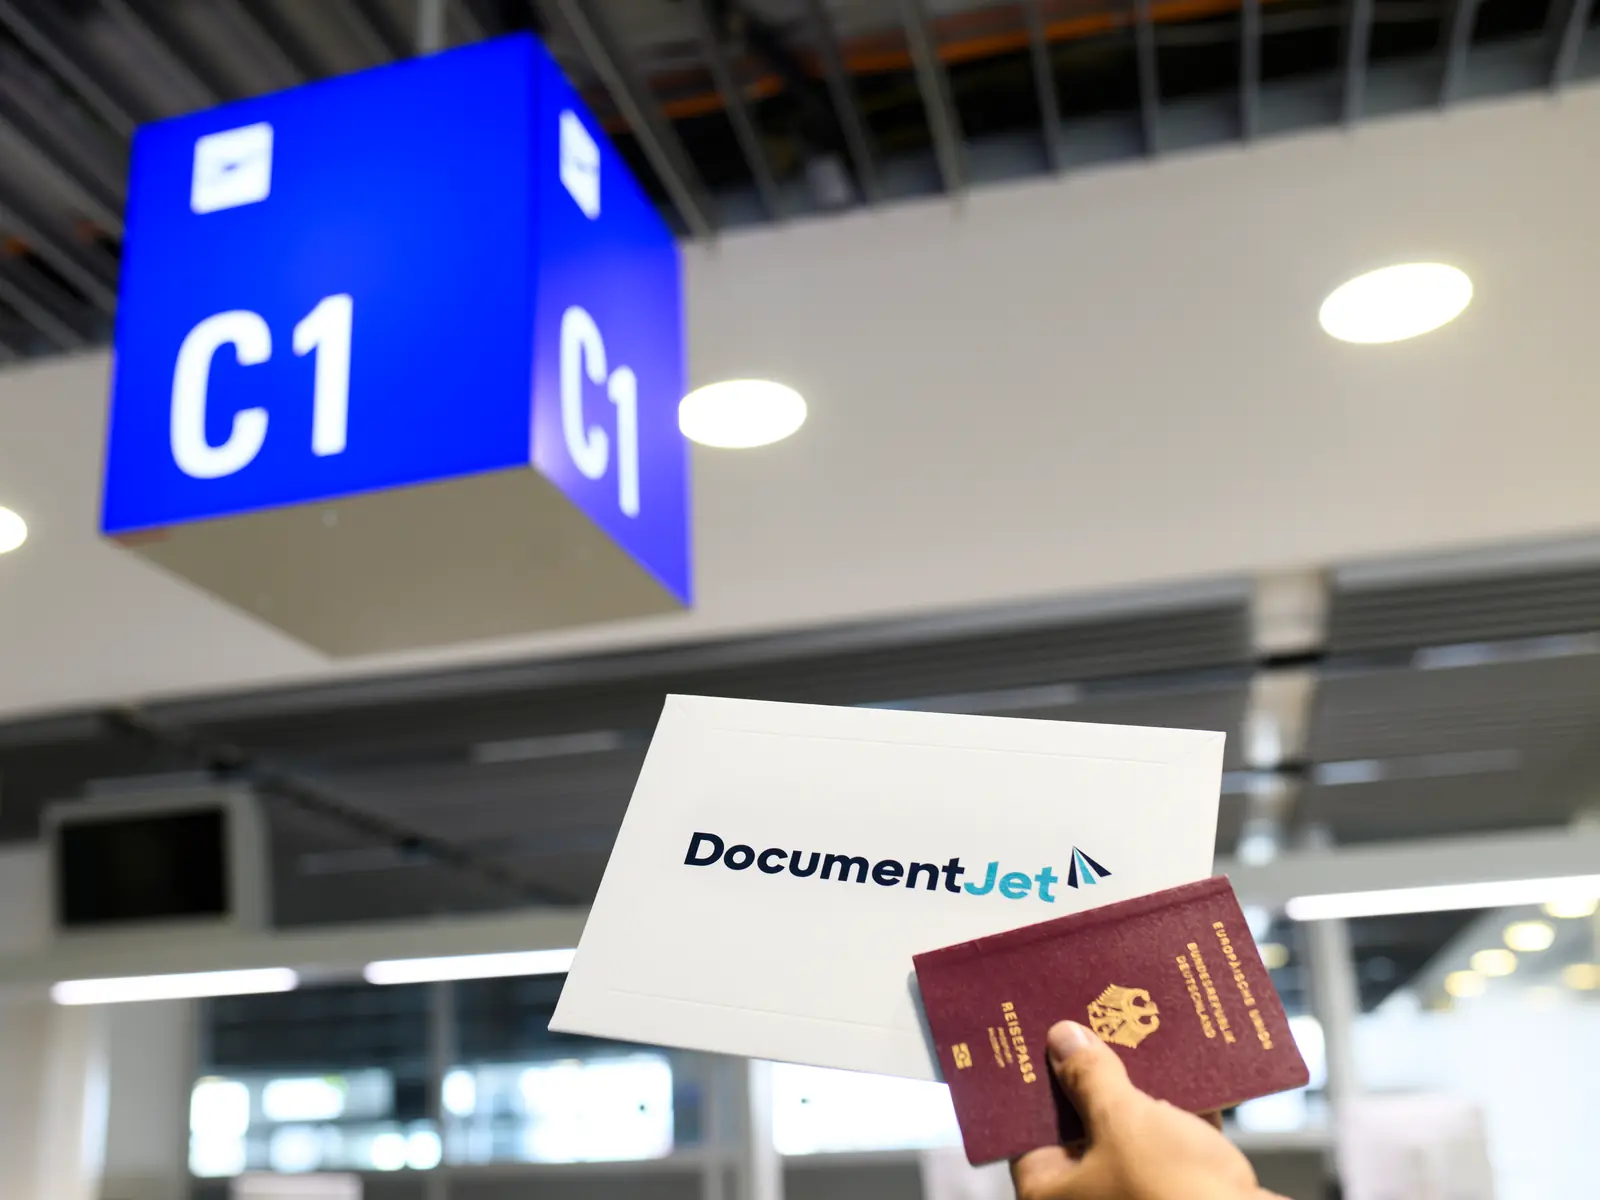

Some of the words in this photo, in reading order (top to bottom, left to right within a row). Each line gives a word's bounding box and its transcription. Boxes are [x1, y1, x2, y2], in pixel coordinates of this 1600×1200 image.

[170, 293, 353, 479] C1
[560, 305, 638, 518] C1
[684, 831, 1058, 903] DocumentJet
[1176, 955, 1216, 1038] DEUTSCHLAND
[1001, 1001, 1036, 1084] REISEPASS
